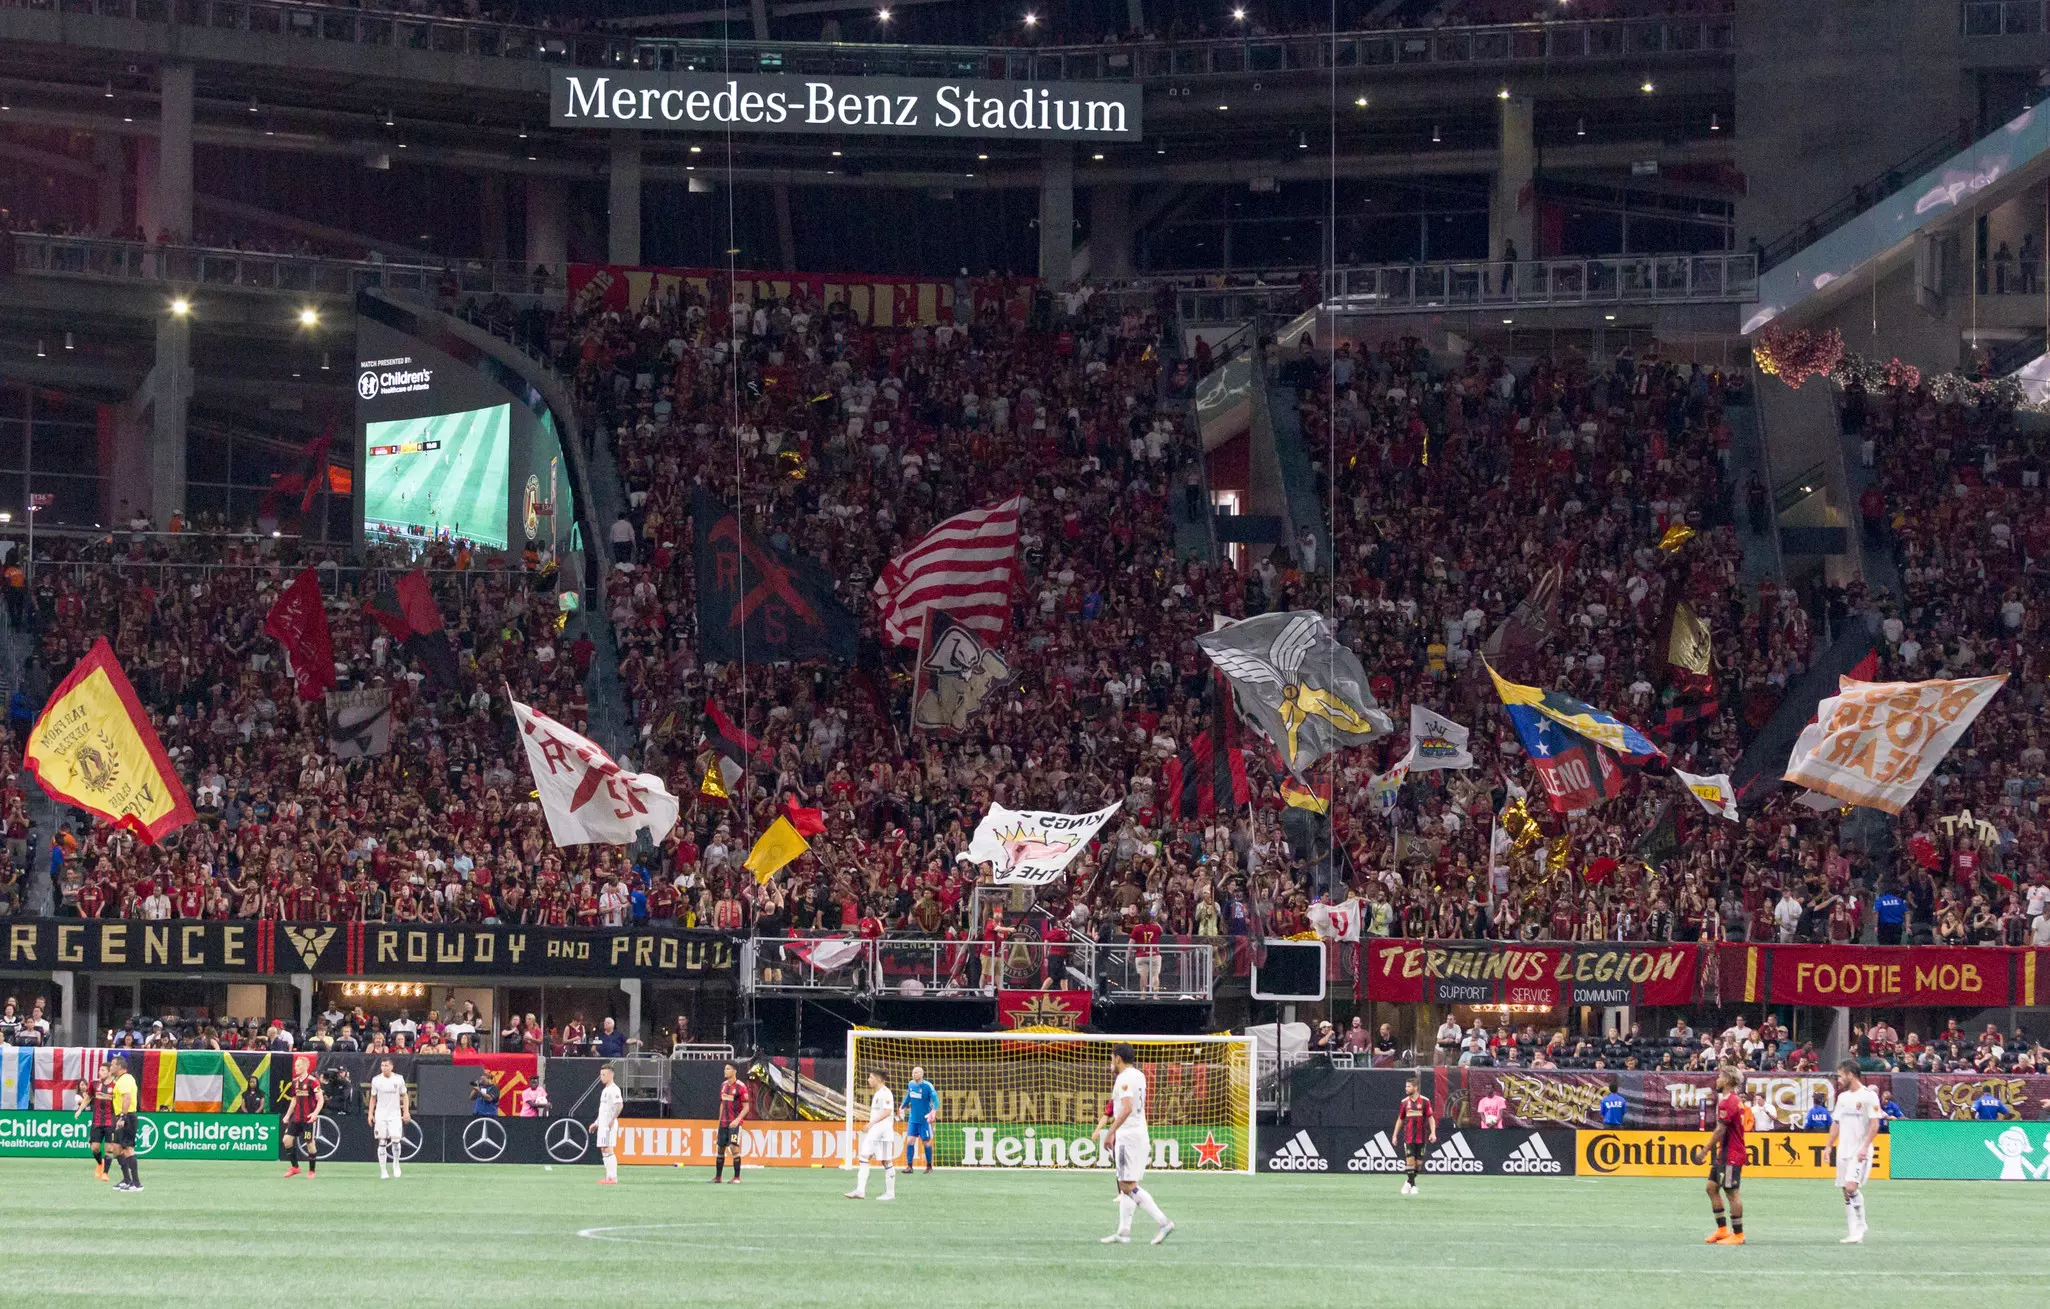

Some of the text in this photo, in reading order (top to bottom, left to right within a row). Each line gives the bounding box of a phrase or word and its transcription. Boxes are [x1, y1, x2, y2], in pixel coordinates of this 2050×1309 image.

[564, 77, 1129, 132] Mercedes-Benz Stadium
[361, 360, 378, 368] MATCH
[378, 357, 404, 367] PRESENTED
[380, 368, 431, 387] Children's
[380, 387, 407, 395] Healthcare
[1940, 808, 2001, 848] TATA
[10, 924, 246, 964] RGENCE
[378, 930, 526, 963] ROWDY
[547, 940, 590, 960] AND
[1379, 945, 1686, 983] TERMINUS LEGION
[1797, 962, 1983, 994] FOOTIE MOB
[1439, 985, 1488, 1000] SUPPORT
[1511, 988, 1552, 1003] SERVICE
[1573, 988, 1631, 1002] COMMUNITY
[1664, 1082, 1714, 1109] THE
[0, 1119, 92, 1138] Children'
[163, 1121, 269, 1141] Children's
[52, 1138, 62, 1148] of
[65, 1139, 91, 1149] Atlan
[164, 1141, 268, 1152] Healthcare of Atlanta
[618, 1127, 691, 1157] THE
[812, 1130, 927, 1160] DEOT
[730, 1134, 738, 1143] 12
[962, 1127, 1183, 1167] Heinen
[1586, 1133, 1881, 1173] Contineal TIE
[1269, 1155, 1329, 1171] adidas
[1347, 1156, 1407, 1172] adidas
[1424, 1157, 1484, 1173] adidas
[1502, 1158, 1562, 1173] adidas
